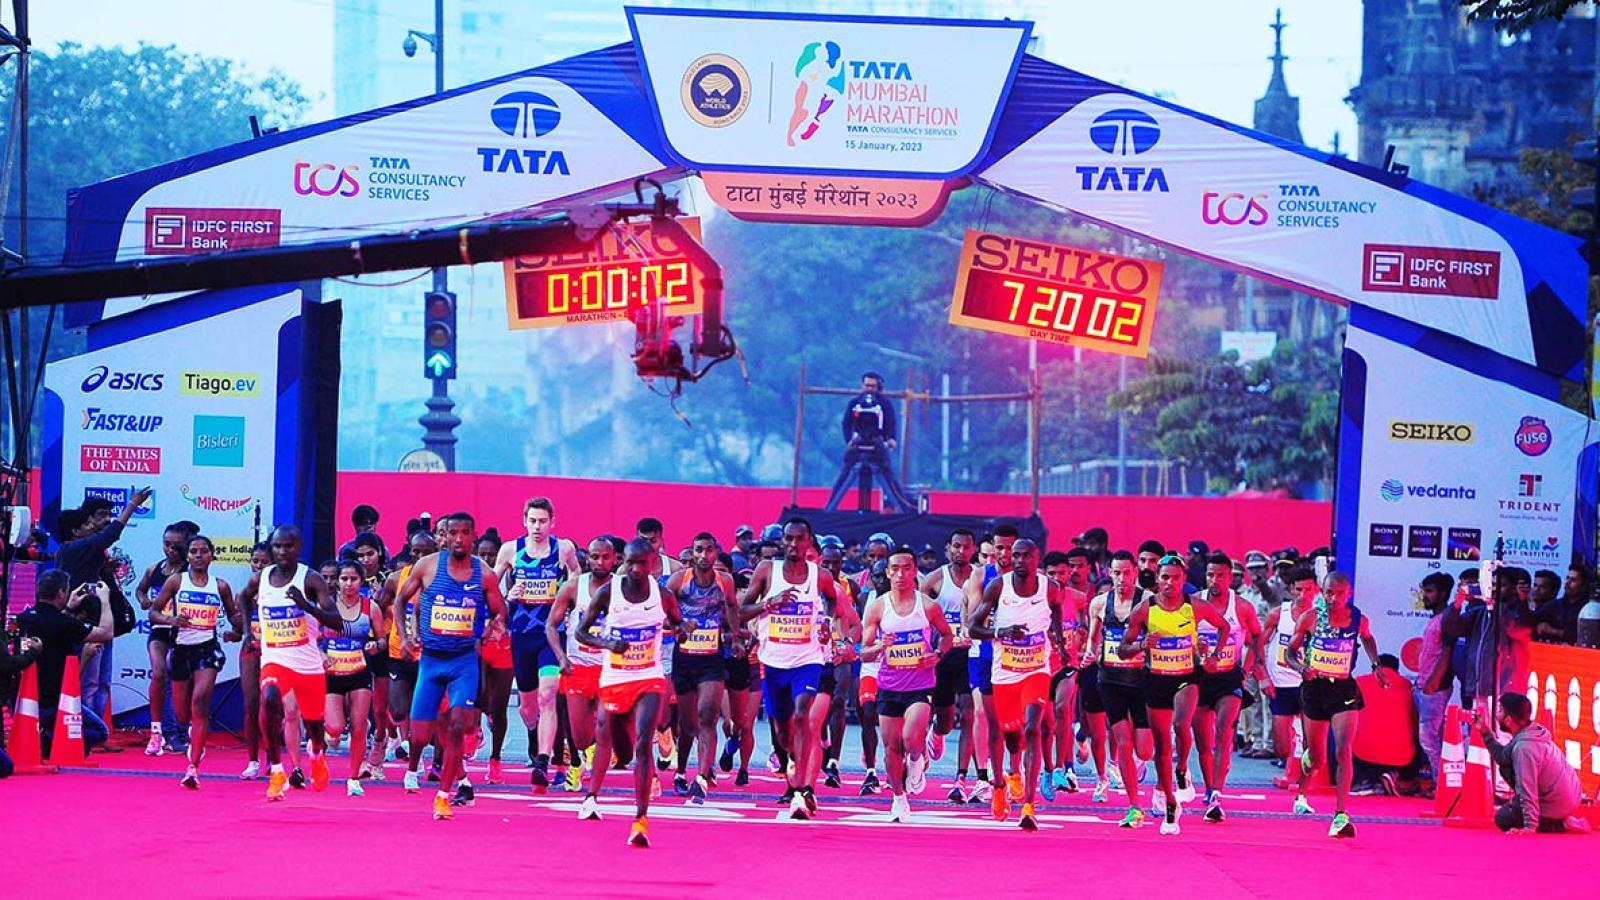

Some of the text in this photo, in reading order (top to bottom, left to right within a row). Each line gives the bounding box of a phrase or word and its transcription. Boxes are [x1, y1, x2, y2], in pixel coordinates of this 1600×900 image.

[849, 61, 912, 80] TATA
[847, 82, 928, 102] MUMBAI
[847, 103, 958, 126] MARATHON
[847, 125, 958, 136] TATA CONSULTANCY SERVICES
[846, 140, 922, 153] 15 January, 2023
[369, 156, 411, 170] TATA
[477, 147, 571, 176] TATA
[369, 172, 466, 188] CONSULTANCY
[1075, 165, 1170, 193] TATA
[368, 187, 430, 201] SERVICES
[726, 185, 762, 202] टाटा
[768, 182, 808, 210] मुंबई
[876, 192, 918, 208] २०२३
[1279, 184, 1320, 197] TATA
[1278, 200, 1377, 215] CONSULTANCY
[192, 220, 273, 233] IDFC FIRST
[1277, 215, 1340, 228] SERVICES
[192, 236, 228, 249] Bank
[973, 234, 1149, 295] SEIKO
[1410, 257, 1492, 276] IDFC FIRST
[1410, 274, 1447, 289] Bank
[566, 312, 616, 323] MARATHON
[1030, 328, 1071, 343] DAY TIME
[185, 374, 255, 394] Tiago.ev
[83, 408, 163, 432] FAST&UP
[1391, 423, 1472, 442] SEIKO
[197, 433, 239, 450] Bisleri
[84, 447, 159, 460] THE TIMES
[89, 460, 150, 472] OF INDIA
[1407, 485, 1476, 500] vedanta
[198, 496, 241, 512] MIRCHI
[1499, 500, 1561, 512] TRIDENT
[230, 545, 252, 554] India
[181, 607, 215, 619] SINGH
[267, 619, 301, 629] MUSAU
[688, 634, 715, 642] EERAJ
[889, 648, 921, 658] ANISH
[1153, 653, 1190, 662] SARVESH
[1314, 654, 1348, 665] LANGAT
